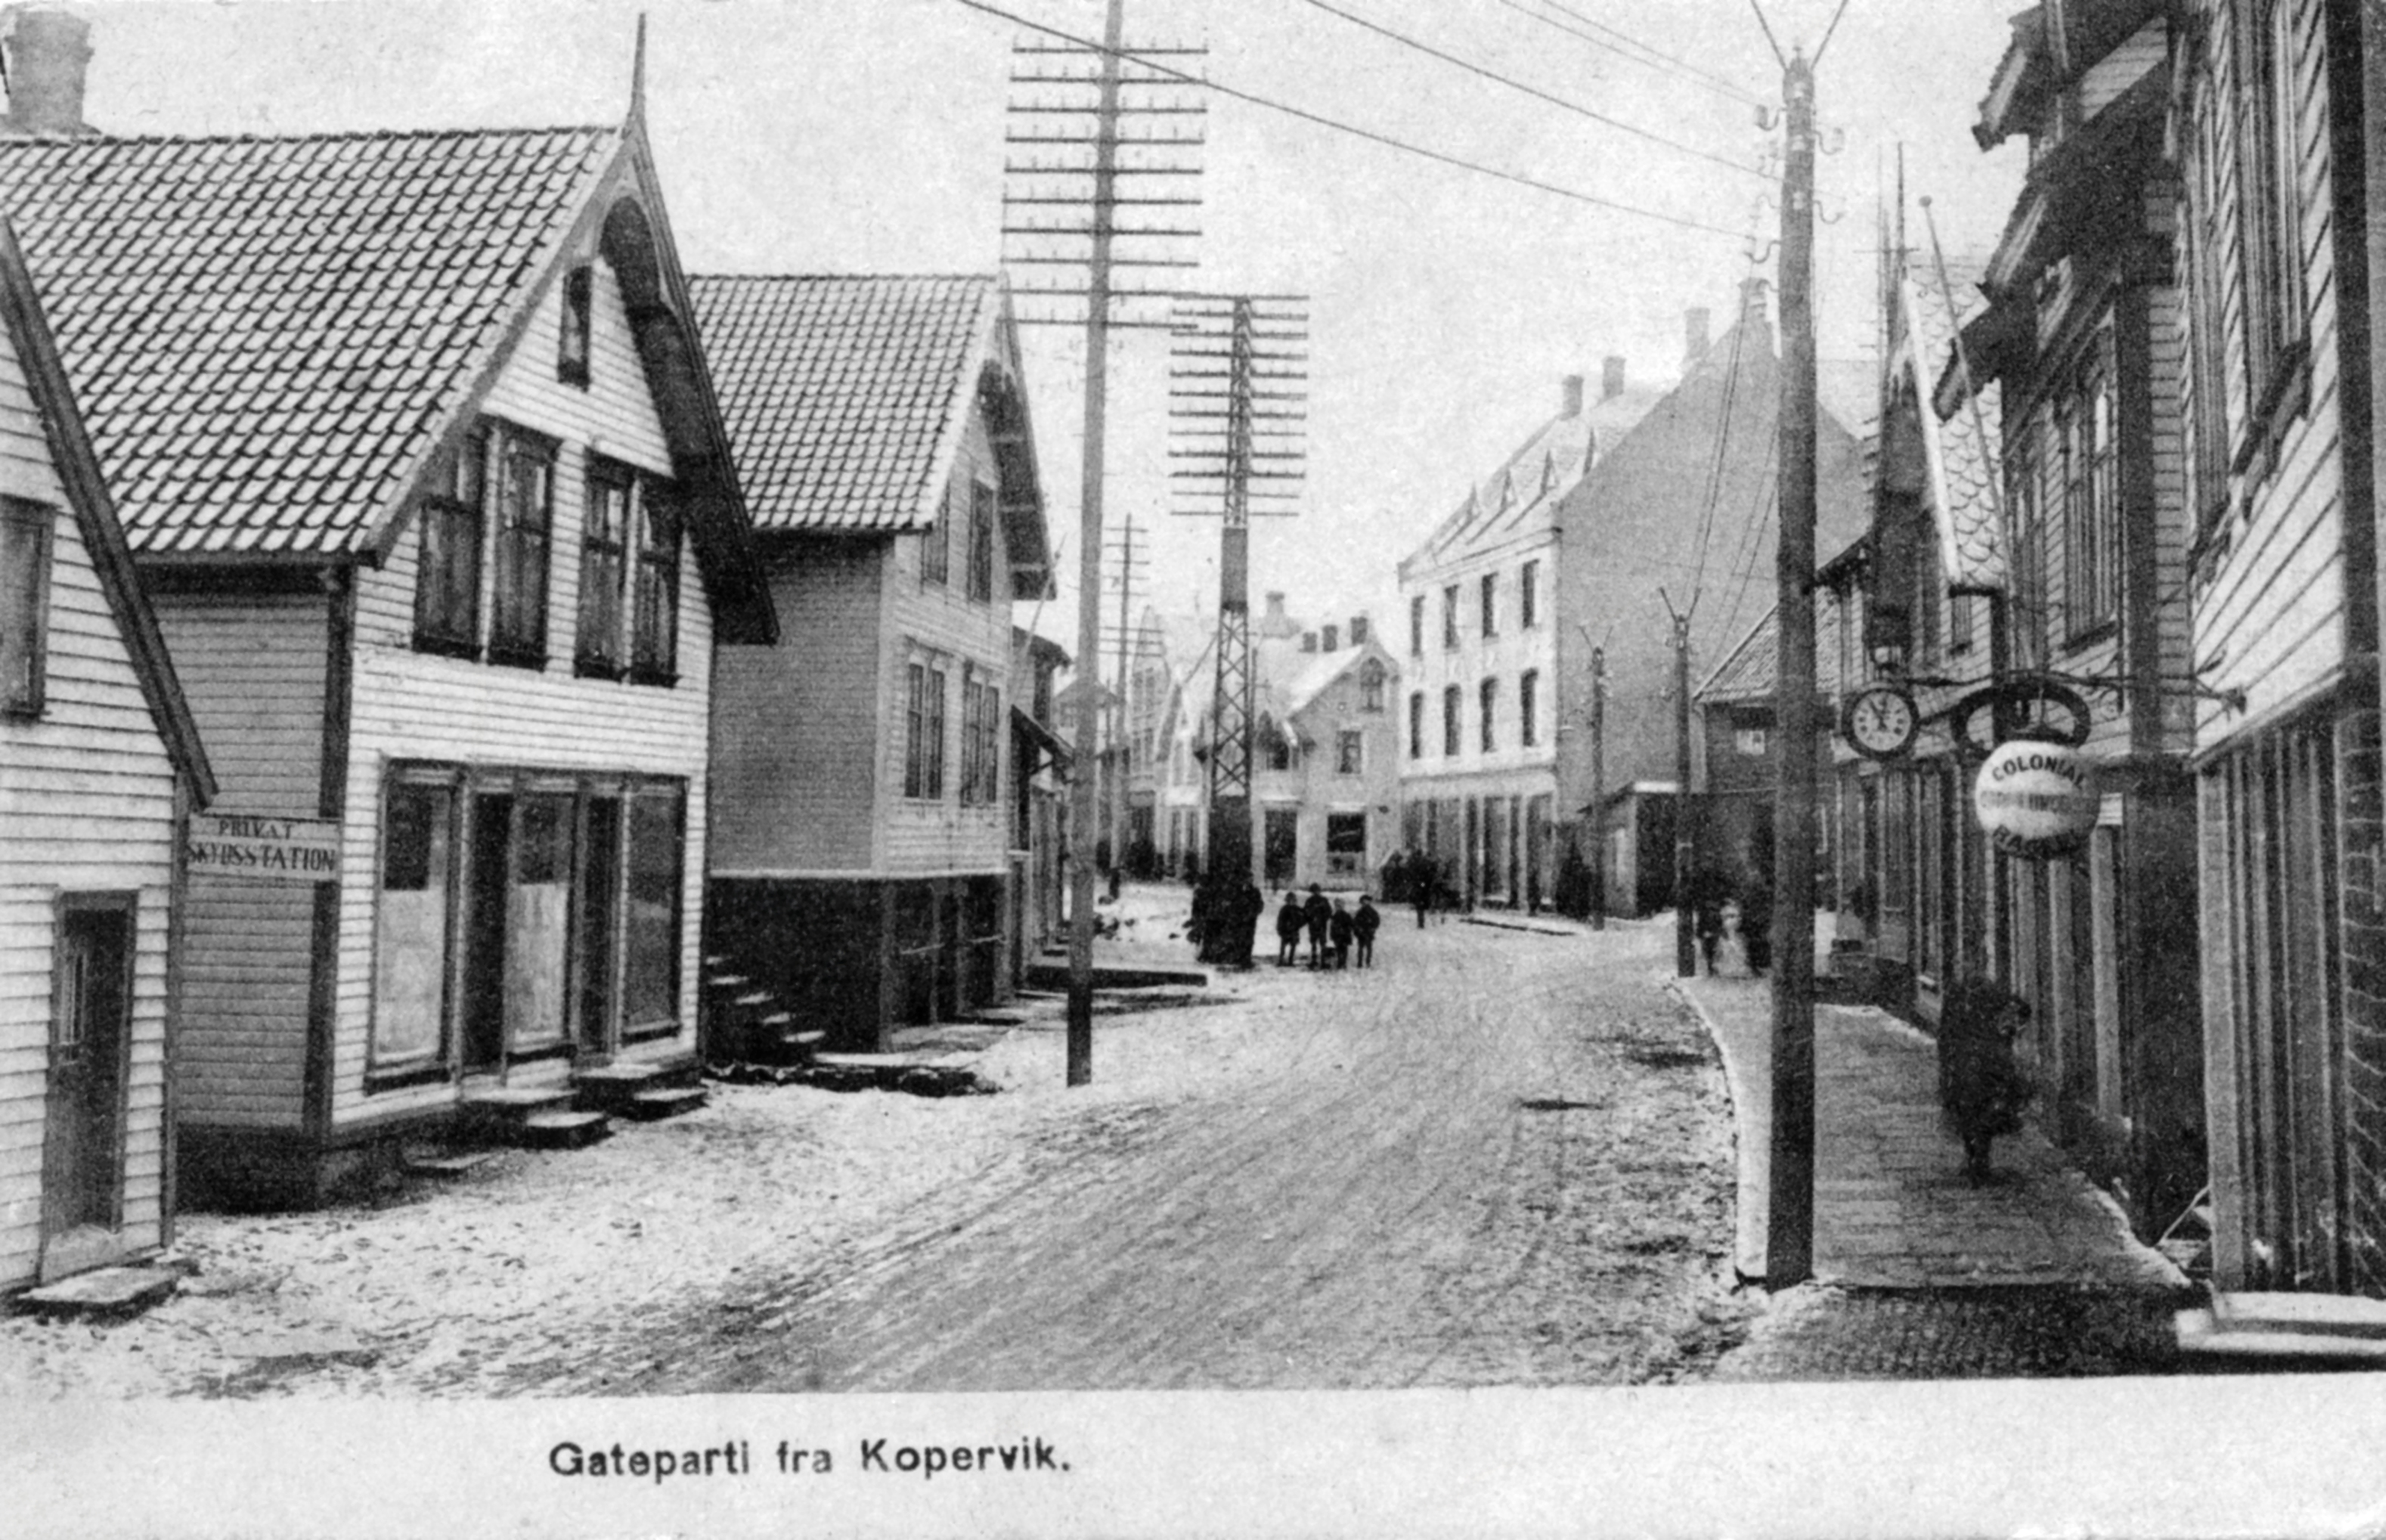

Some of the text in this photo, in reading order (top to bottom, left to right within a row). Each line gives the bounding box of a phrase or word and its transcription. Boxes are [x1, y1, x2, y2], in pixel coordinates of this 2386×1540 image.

[1991, 754, 2085, 791] COLONIAL
[218, 820, 293, 839] PRIVAT
[185, 841, 336, 871] SKYDSSTATION
